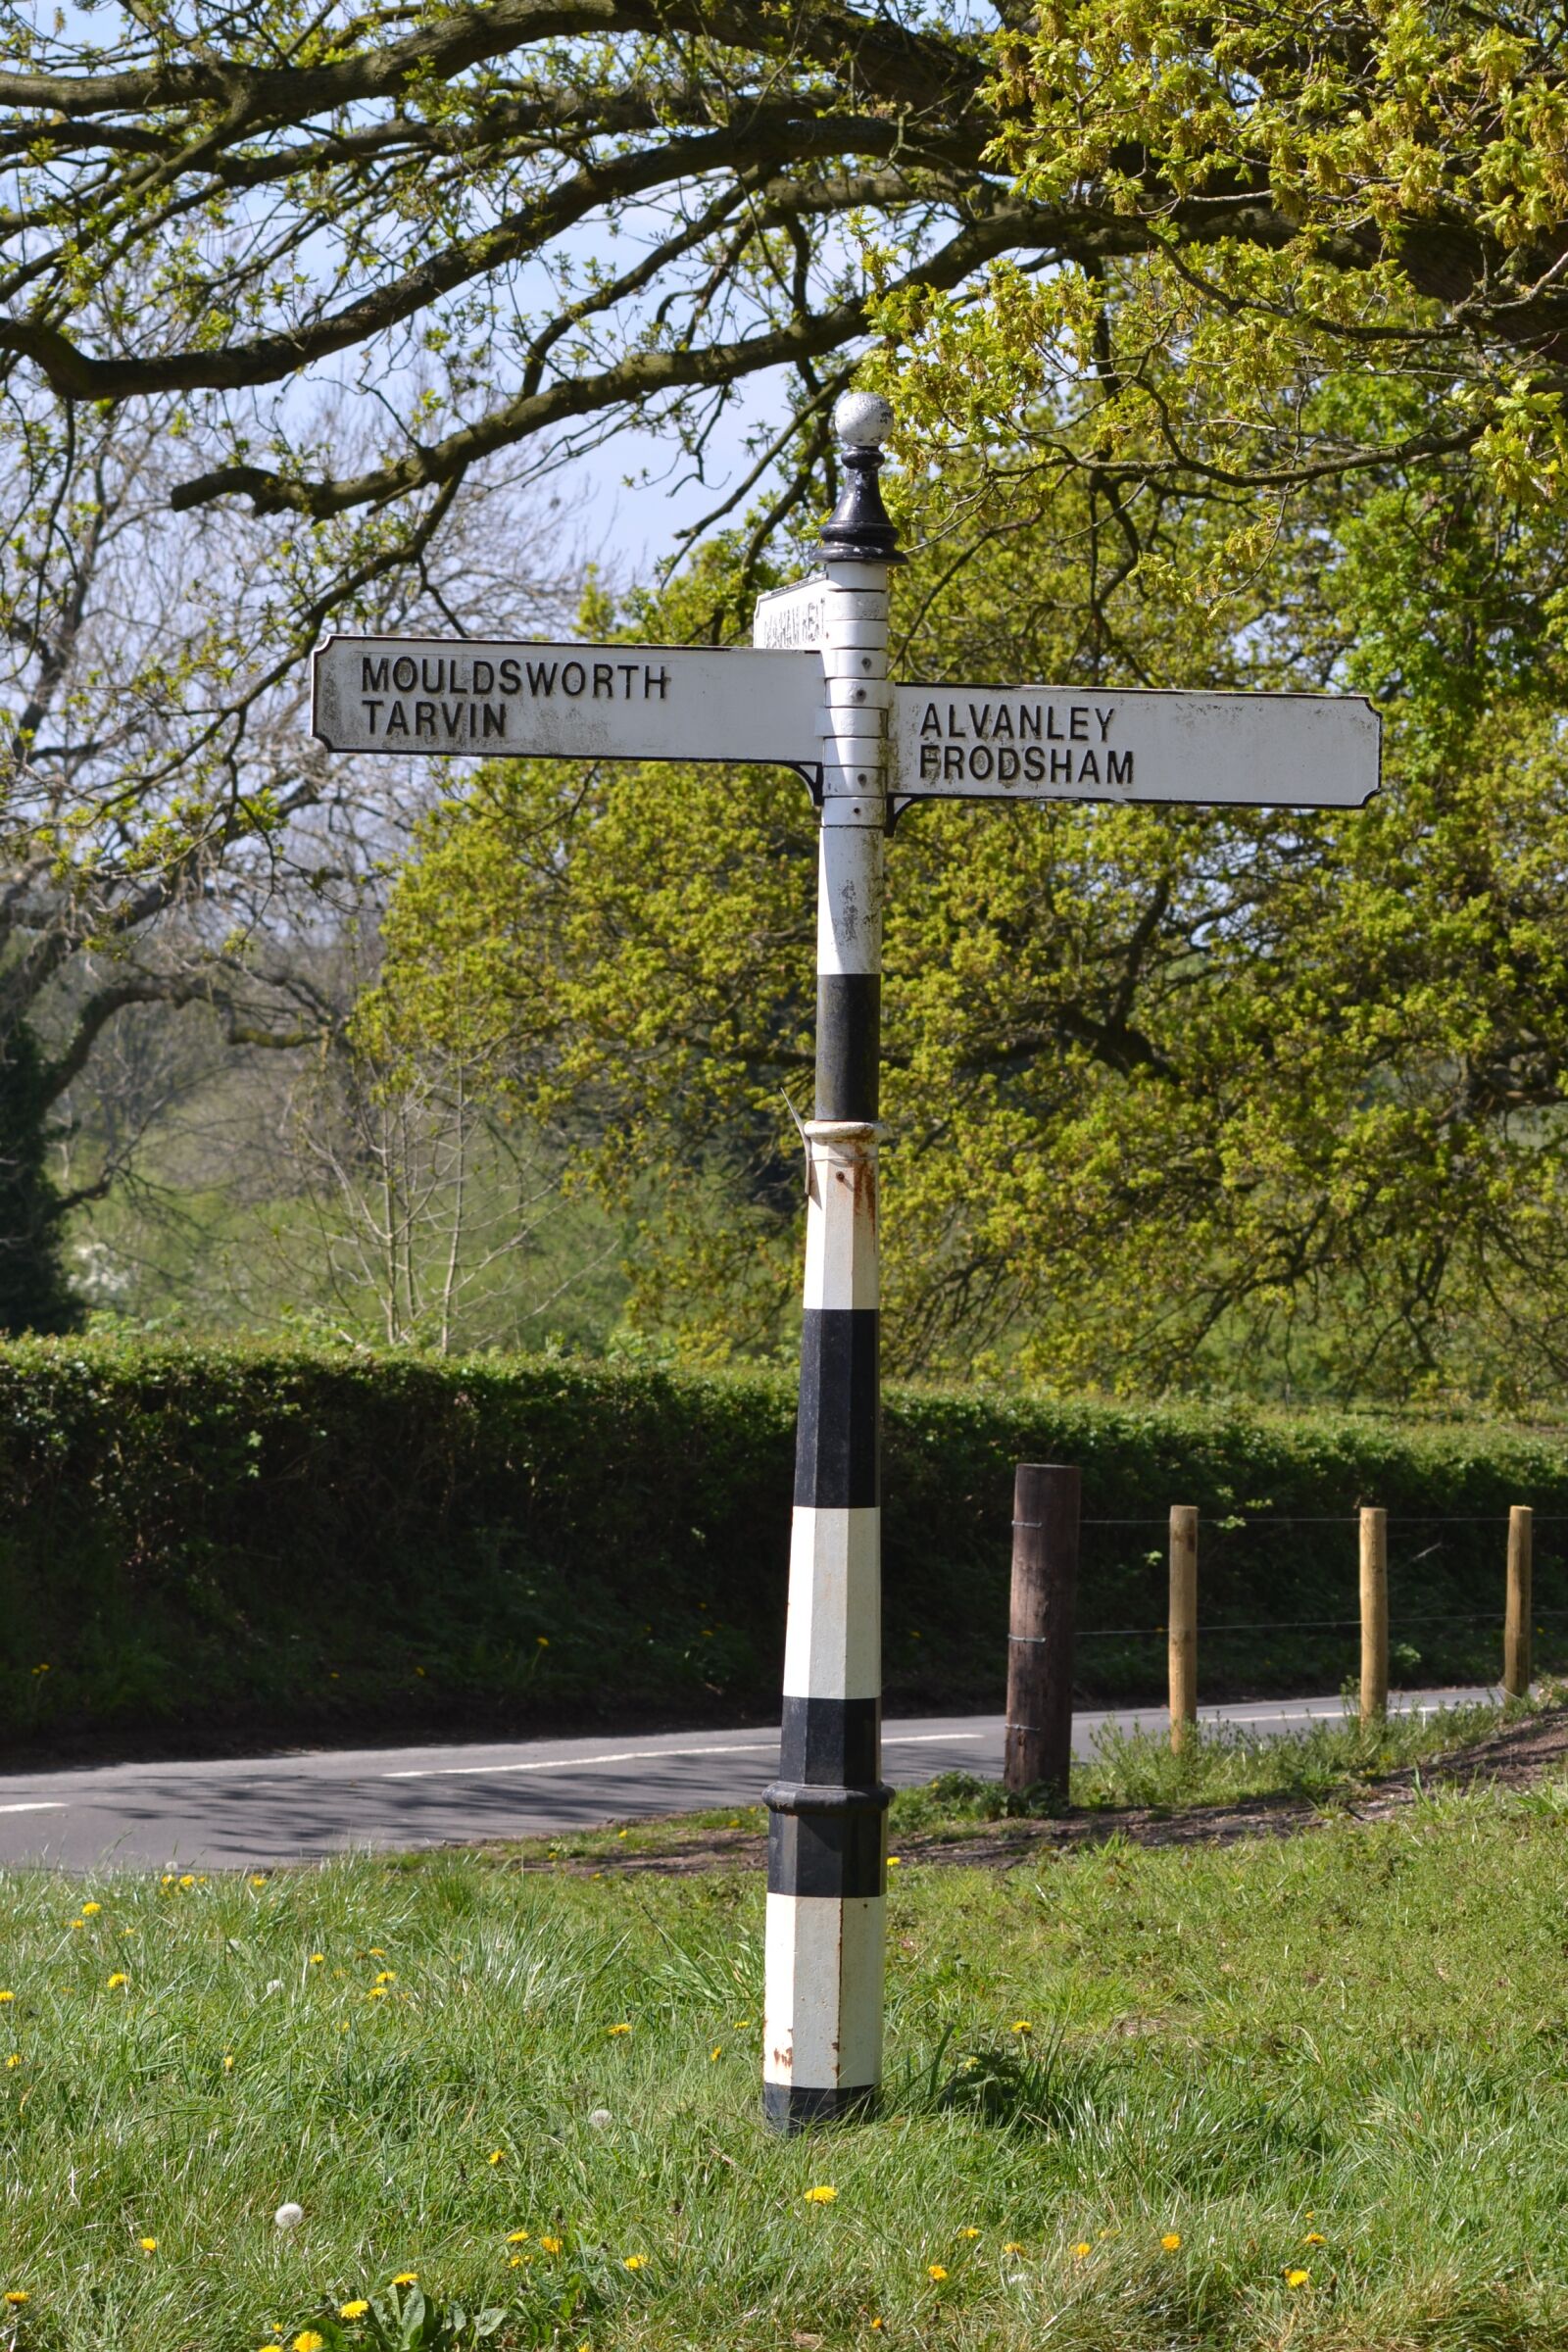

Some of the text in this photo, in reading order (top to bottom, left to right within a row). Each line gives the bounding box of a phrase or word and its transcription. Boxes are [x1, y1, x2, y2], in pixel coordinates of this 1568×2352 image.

[362, 657, 669, 700] MOULDSWORTH
[362, 700, 508, 738] TARVIN
[920, 703, 1115, 742] ALVANLEY
[919, 744, 1135, 784] FRODSHAM
